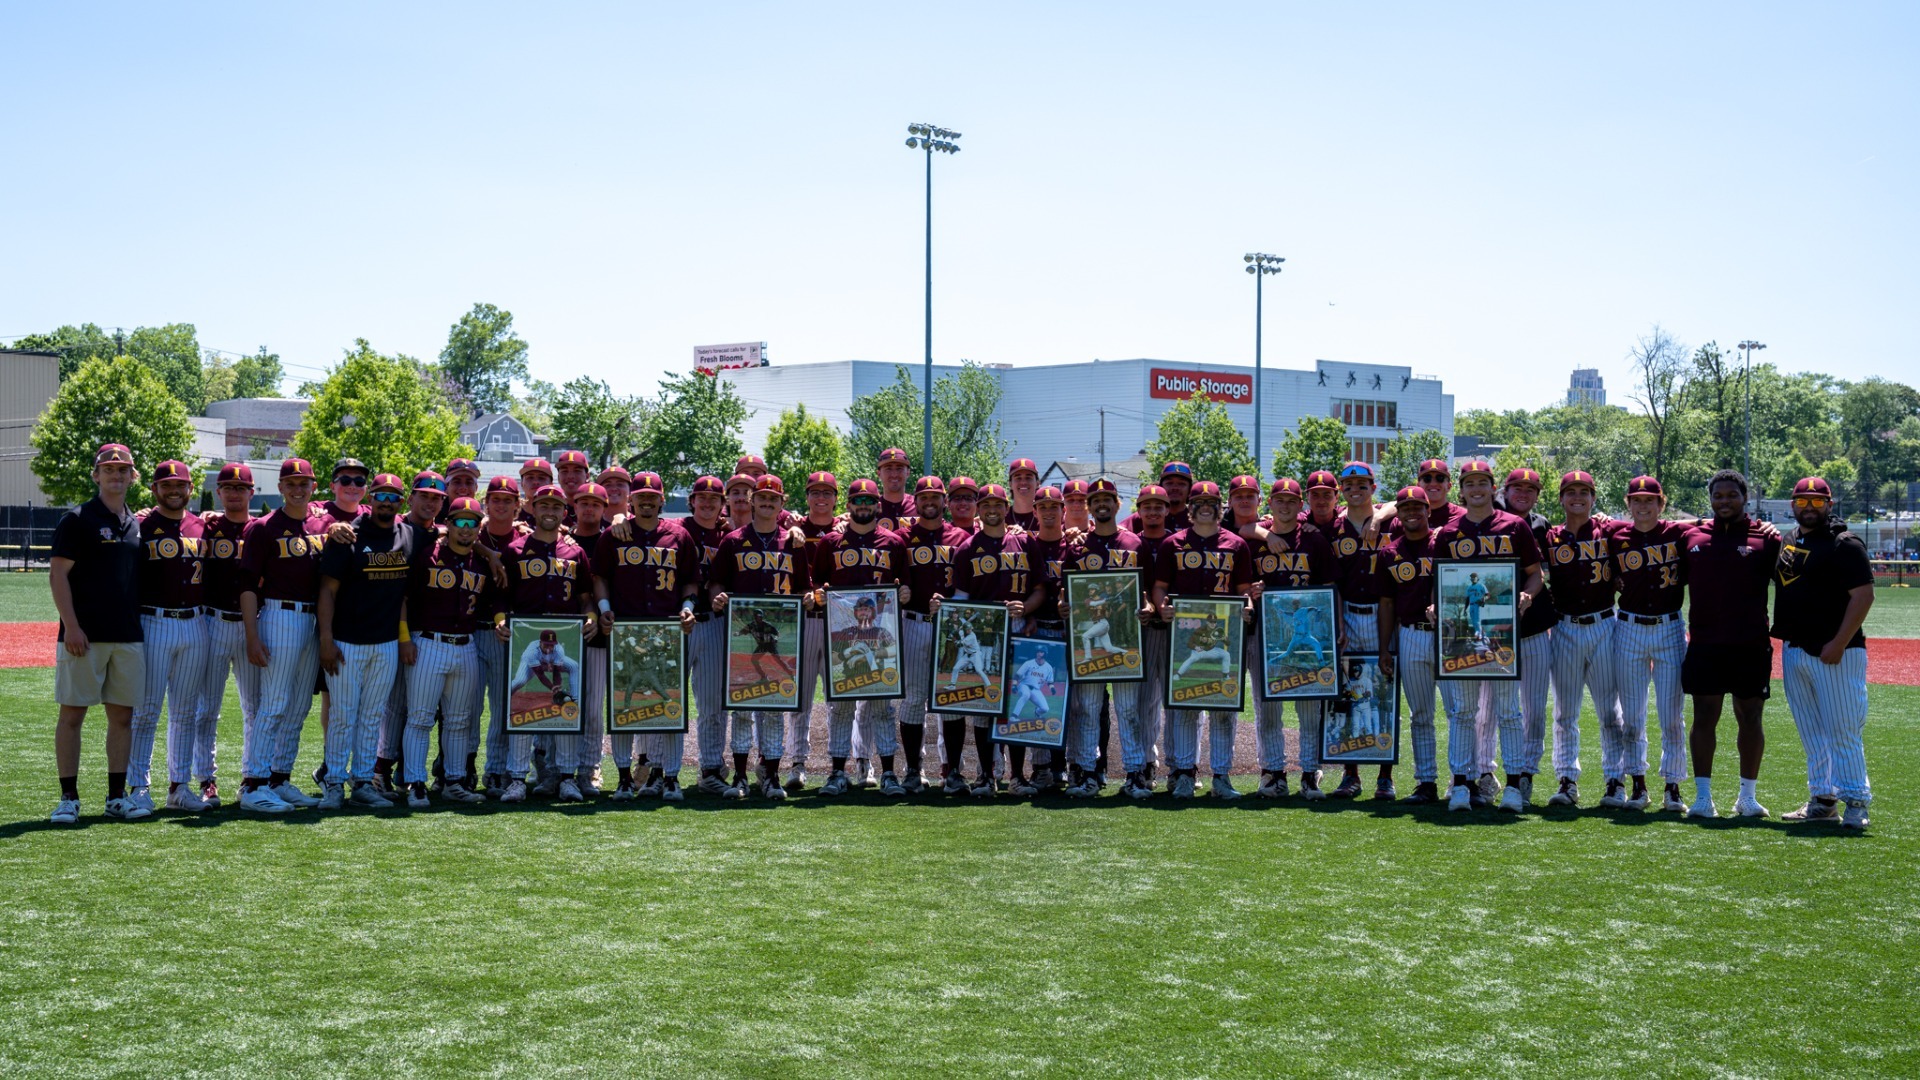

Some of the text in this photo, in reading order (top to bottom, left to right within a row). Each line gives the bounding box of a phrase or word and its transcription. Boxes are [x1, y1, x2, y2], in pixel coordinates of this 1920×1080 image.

[1157, 375, 1248, 400] Public Storage
[616, 546, 678, 569] IONA
[1449, 536, 1514, 559] IONA
[1548, 538, 1610, 566] IONA
[1616, 541, 1680, 572] IONA
[367, 551, 407, 566] IONA
[517, 556, 578, 580] IONA
[734, 552, 794, 574] IONA
[832, 548, 892, 570] IONA
[970, 552, 1030, 578] IONA
[1076, 549, 1138, 570] IONA
[1174, 552, 1235, 570] IONA
[1253, 552, 1311, 576] IONA
[368, 572, 407, 580] BASEBALL
[874, 572, 882, 584] 7
[1214, 572, 1230, 593] 21
[1590, 560, 1612, 584] 36
[1660, 563, 1678, 588] 32
[563, 580, 572, 601] 3
[772, 572, 791, 594] 14
[1010, 573, 1026, 594] 11
[1078, 654, 1122, 676] GAELS
[1445, 650, 1494, 671] GAELS
[732, 682, 778, 700] GAELS
[836, 670, 880, 692] GAELS
[1174, 682, 1220, 700] GAELS
[1270, 672, 1316, 692] GAELS
[938, 687, 984, 704] GAELS
[512, 705, 560, 725] GAELS
[616, 704, 664, 725] GAELS
[998, 720, 1044, 735] GAELS
[1328, 736, 1374, 754] GAELS
